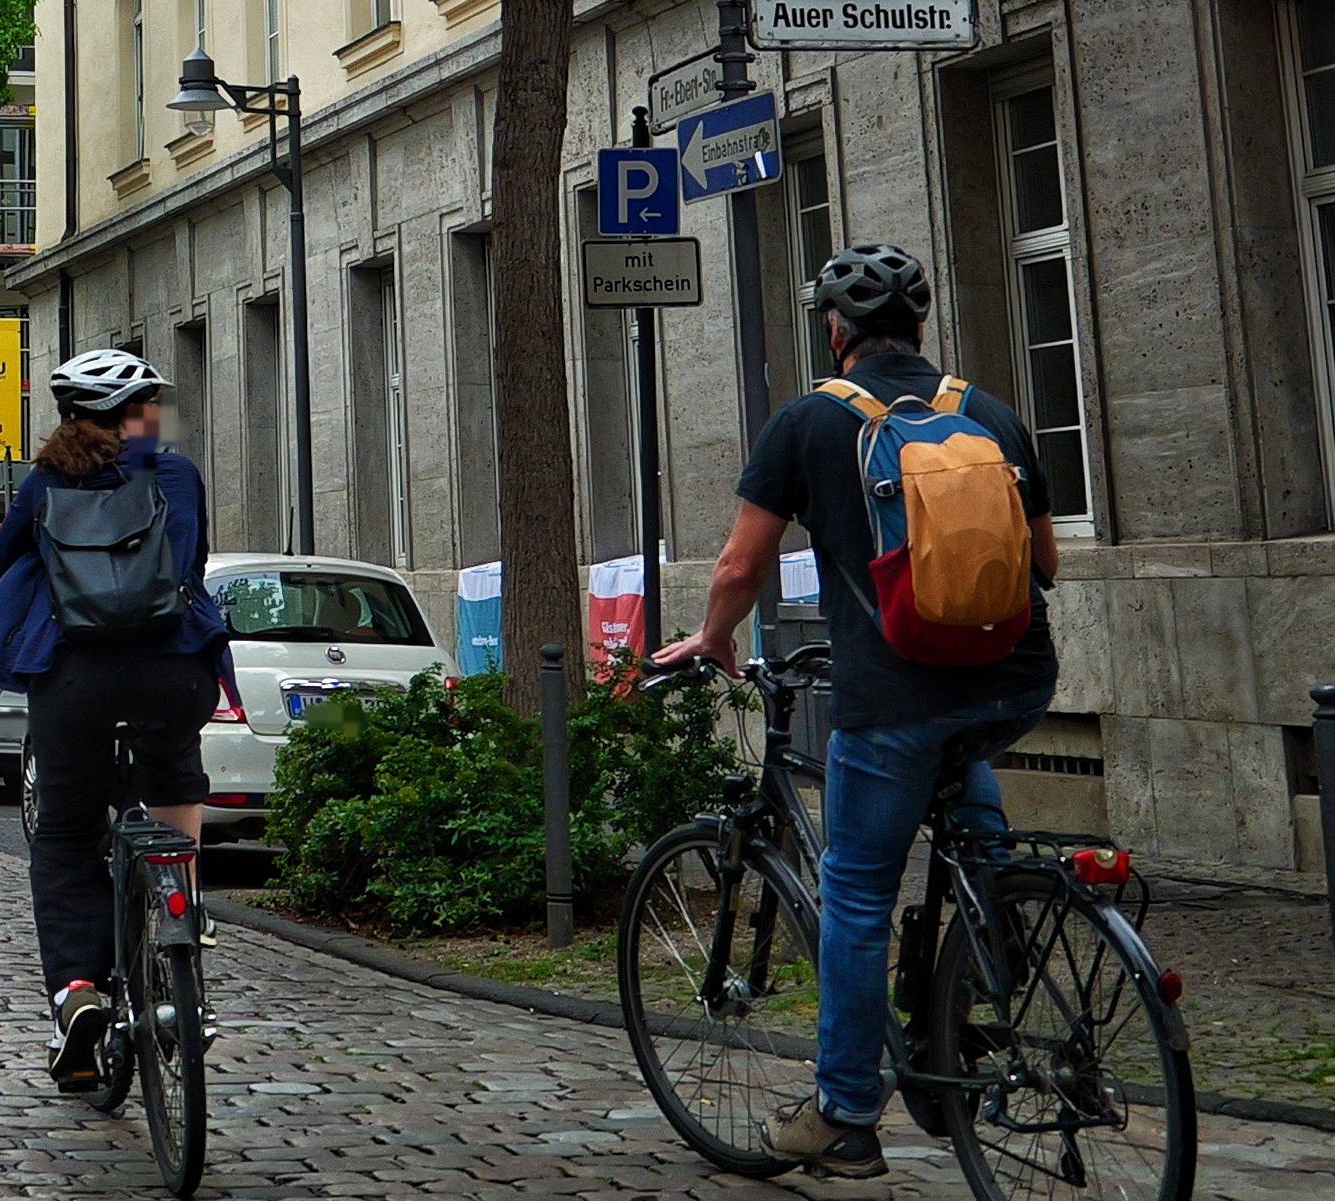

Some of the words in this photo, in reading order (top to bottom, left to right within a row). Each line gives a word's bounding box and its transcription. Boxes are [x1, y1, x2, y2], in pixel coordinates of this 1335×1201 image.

[772, 2, 834, 28] Auer
[842, 2, 952, 29] Schulstr.
[659, 67, 719, 113] Fr.-Ebert-Str
[624, 252, 654, 268] mit
[593, 276, 691, 292] Parkschein
